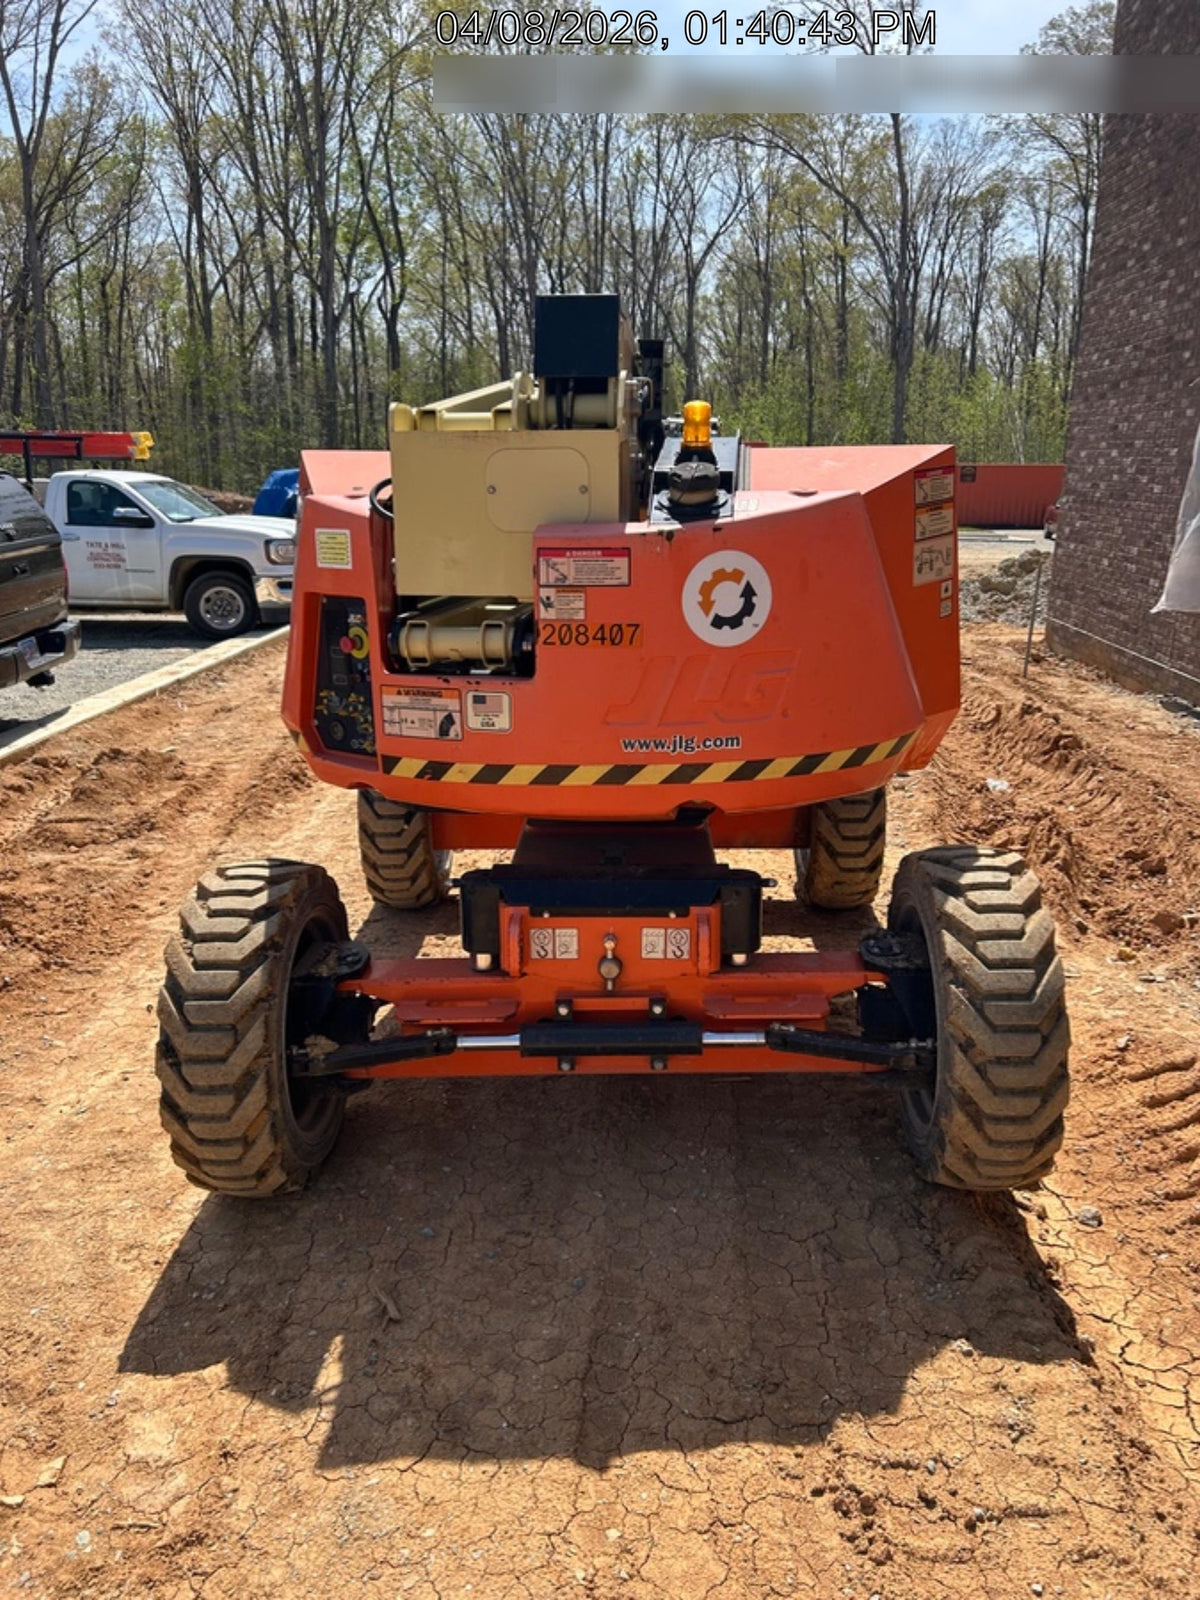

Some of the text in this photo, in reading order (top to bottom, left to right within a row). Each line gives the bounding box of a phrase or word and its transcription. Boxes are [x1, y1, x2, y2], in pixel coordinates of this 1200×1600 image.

[403, 688, 443, 698] WARNING
[603, 651, 798, 727] JLG
[621, 734, 742, 754] www.jlg.com
